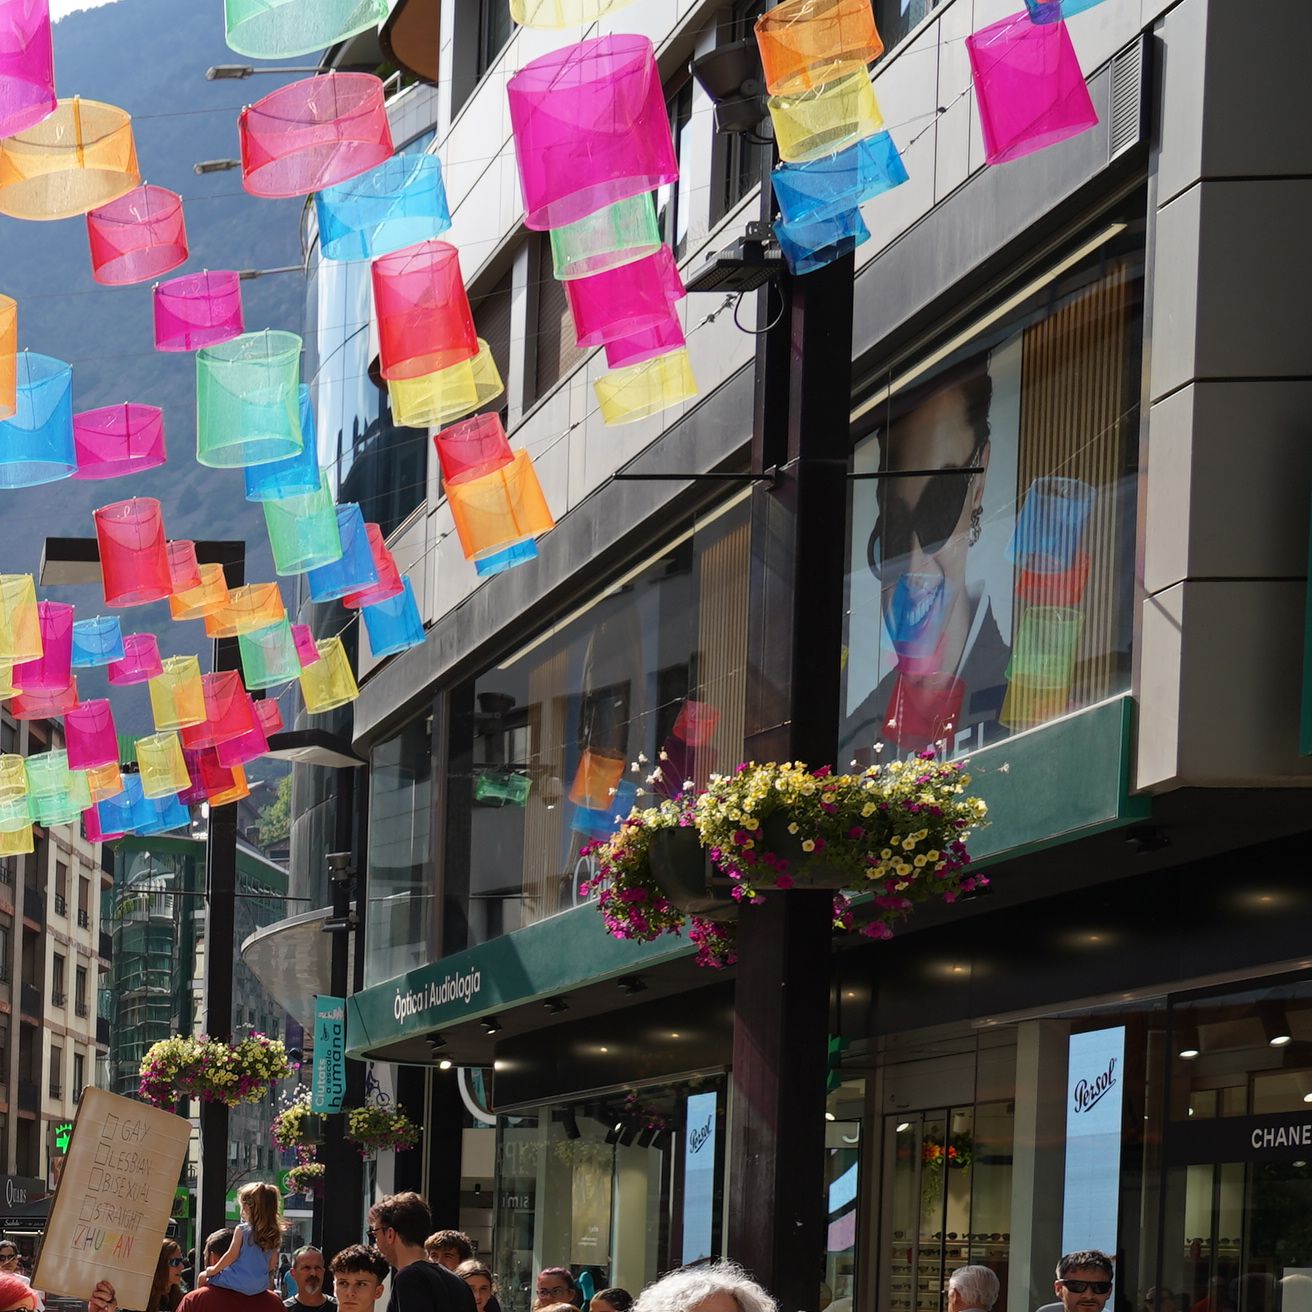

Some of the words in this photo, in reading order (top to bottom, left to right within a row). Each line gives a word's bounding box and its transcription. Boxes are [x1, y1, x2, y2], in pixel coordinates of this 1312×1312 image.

[429, 967, 481, 1007] Audiologia
[328, 1024, 342, 1108] humana
[1074, 1058, 1117, 1113] Persol
[121, 1119, 152, 1142] GAY
[1251, 1124, 1312, 1149] CHANE
[108, 1148, 153, 1177] LESBIAN
[102, 1173, 152, 1203] BISEXUAL
[94, 1202, 144, 1232] STRAIGHT
